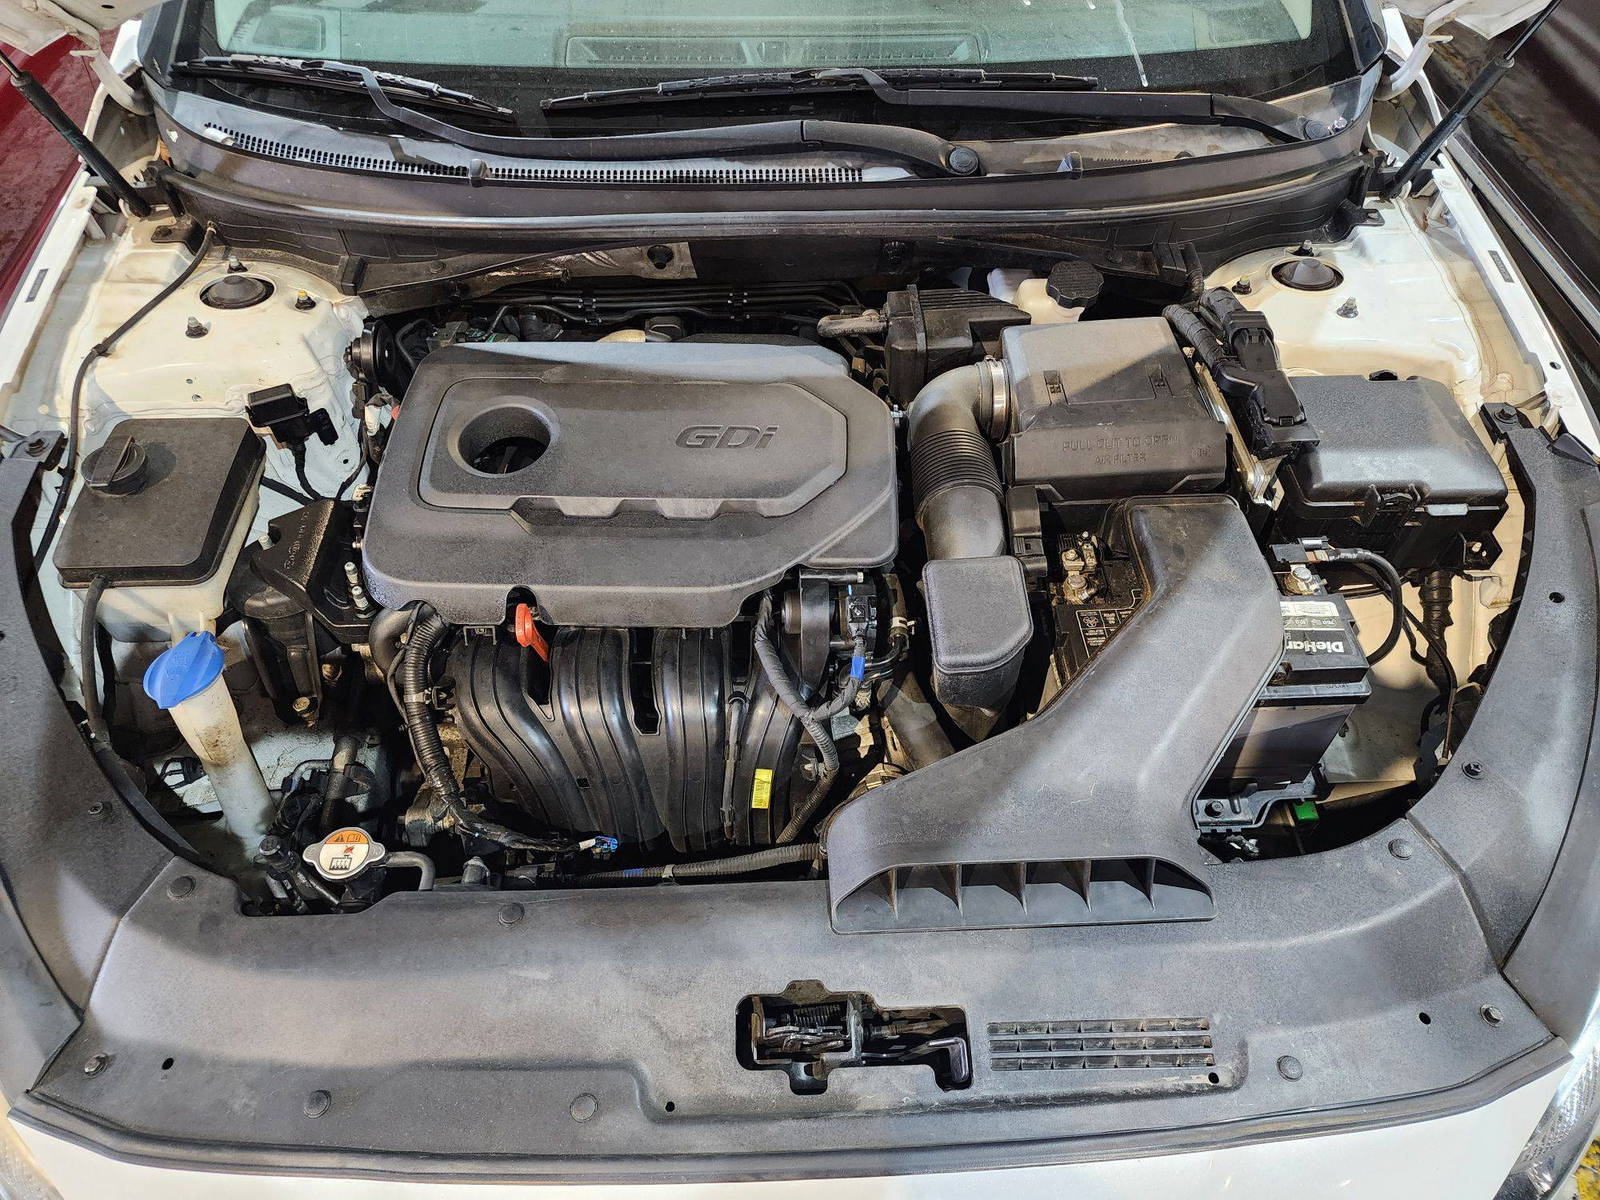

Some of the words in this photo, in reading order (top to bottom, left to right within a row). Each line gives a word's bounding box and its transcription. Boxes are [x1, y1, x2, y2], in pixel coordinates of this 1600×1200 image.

[675, 424, 779, 449] GDi
[1062, 439, 1092, 451] PULL
[1096, 437, 1121, 449] OUT
[1125, 436, 1141, 448] TO
[1286, 640, 1344, 653] DieHar
